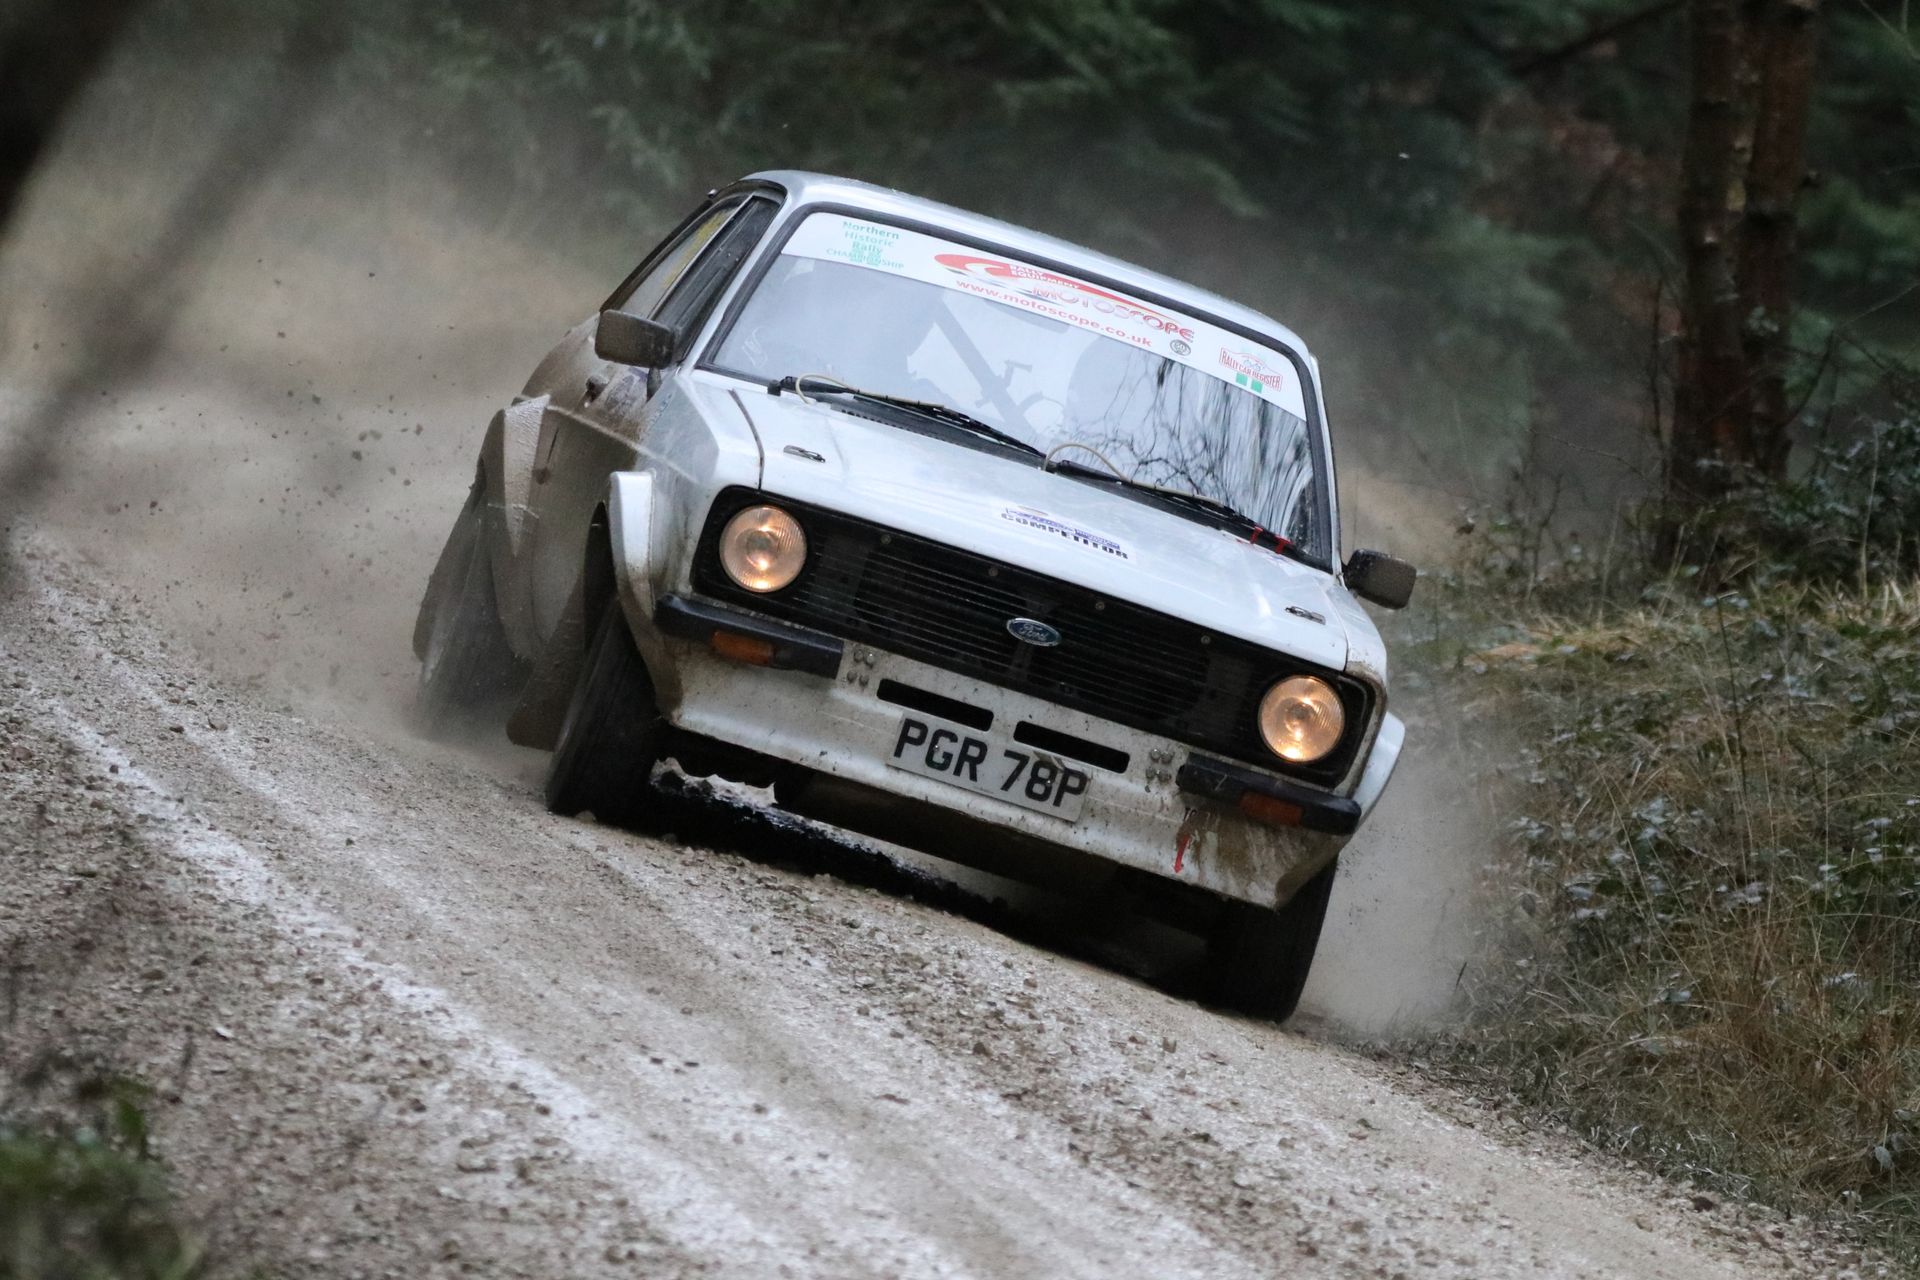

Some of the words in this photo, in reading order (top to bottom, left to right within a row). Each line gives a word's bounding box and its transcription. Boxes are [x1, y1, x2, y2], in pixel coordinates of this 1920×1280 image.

[843, 221, 899, 240] Northern
[845, 231, 895, 247] Historic
[852, 241, 882, 255] Rally
[956, 279, 1152, 347] www.motoscope.co.uk
[1002, 513, 1128, 559] COMPETITOR
[893, 718, 988, 782] PGR
[1000, 749, 1088, 807] 78P
